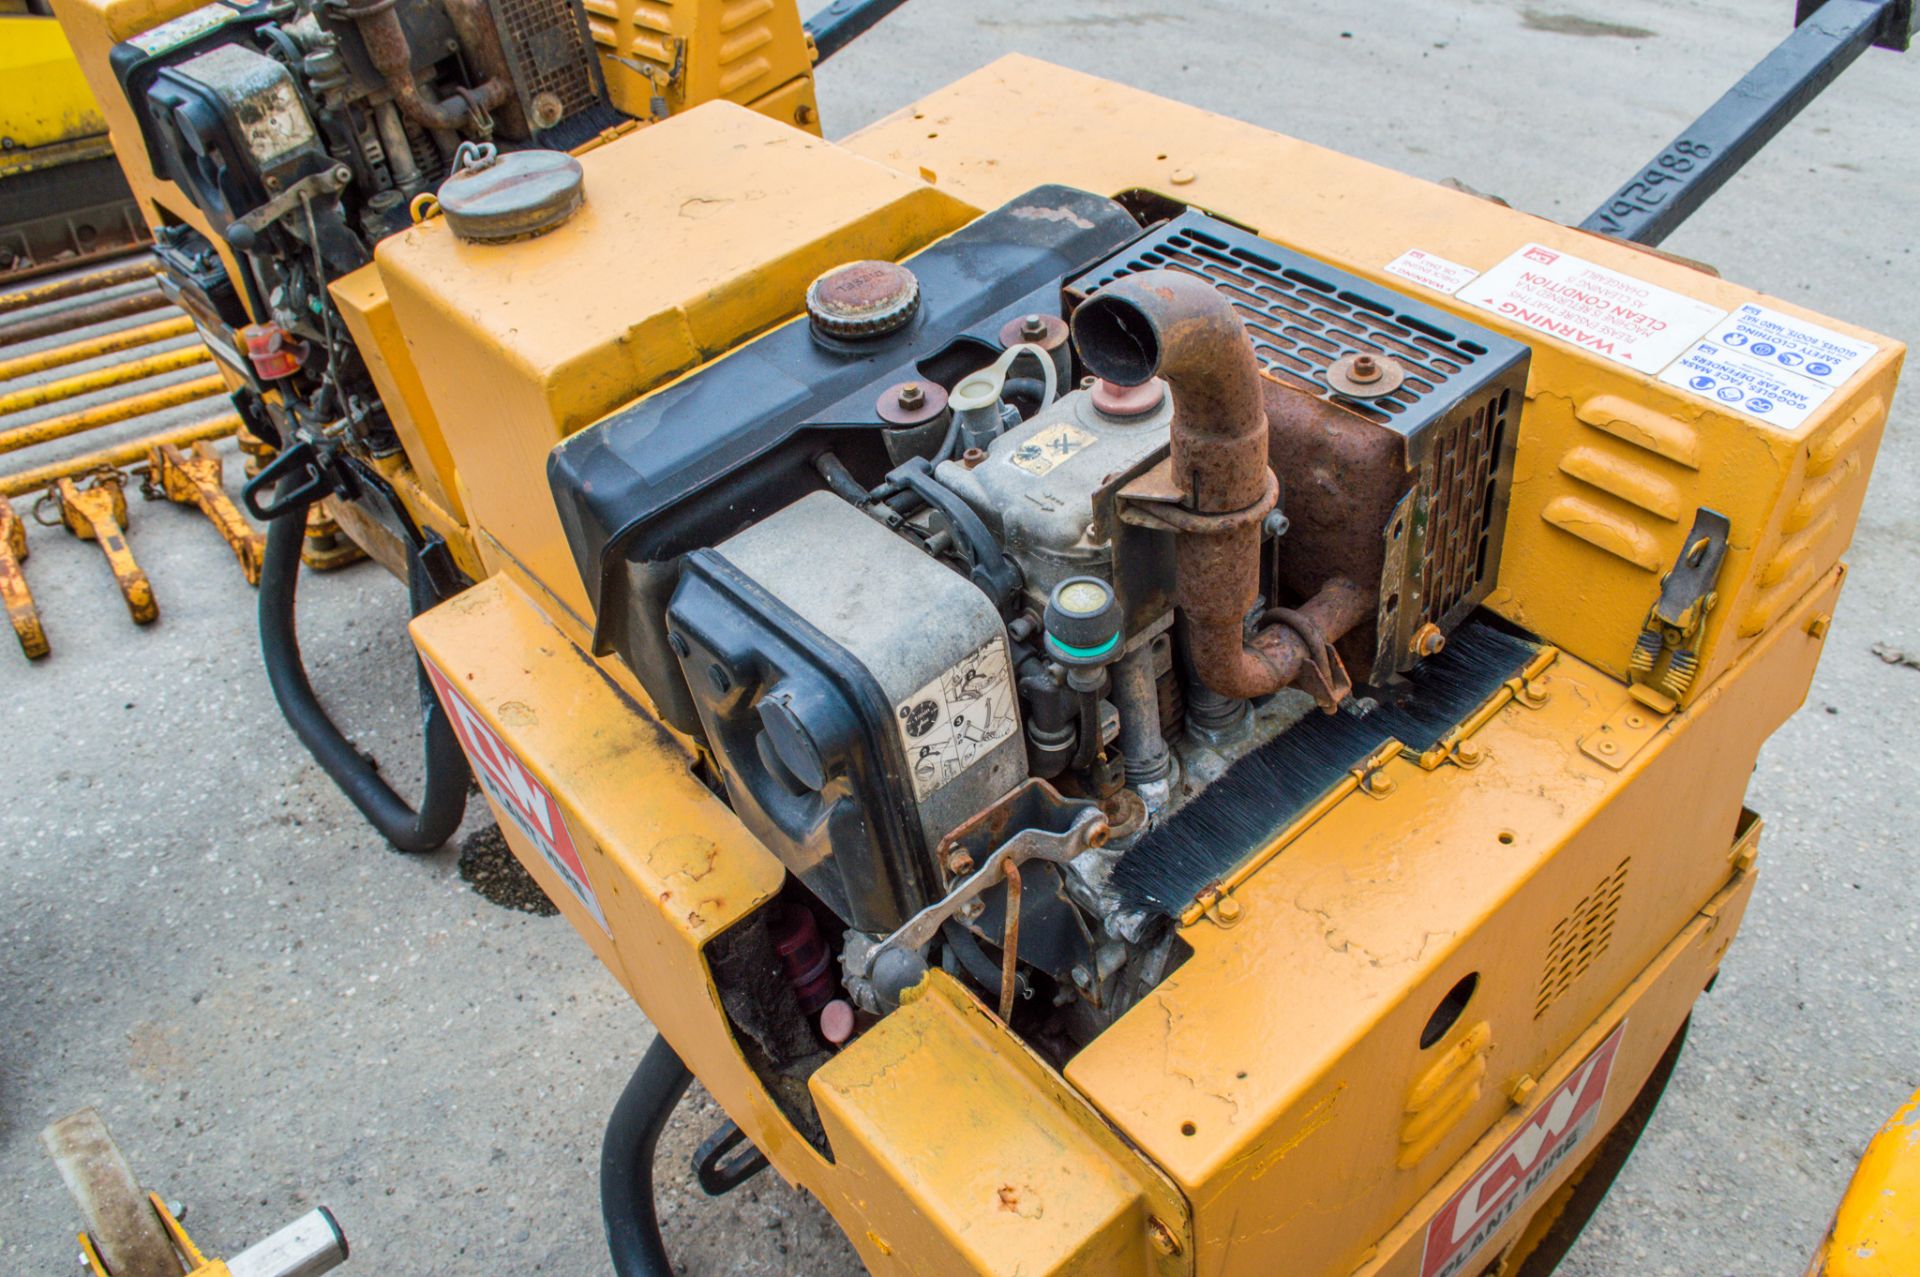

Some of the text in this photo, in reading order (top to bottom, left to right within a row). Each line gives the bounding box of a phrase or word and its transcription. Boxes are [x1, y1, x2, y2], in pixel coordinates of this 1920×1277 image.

[1574, 279, 1632, 303] CLEANING
[1580, 269, 1651, 298] CHARGEABLE
[1518, 271, 1668, 331] CLEAN CONDITION
[1535, 288, 1593, 314] RETURNED
[1496, 301, 1614, 354] WARNING
[1506, 290, 1637, 344] PLEASE ENSURE THAT THIS
[1600, 313, 1654, 337] MACHINE
[1741, 313, 1760, 323] HAT
[1758, 319, 1785, 332] HARD
[1734, 323, 1798, 349] CLOTHING
[1818, 340, 1858, 357] GLOVES,
[1679, 358, 1712, 374] MASK
[1690, 354, 1756, 382] DEFENDERS
[1798, 346, 1842, 365] SAFETY
[1713, 371, 1744, 386] FACE
[1755, 379, 1779, 391] EAR
[1744, 382, 1807, 410] GOGGLES,
[1780, 388, 1809, 402] AND
[446, 686, 555, 844] CW
[482, 770, 539, 847] PLANT
[1451, 1053, 1600, 1244] CW
[1440, 1128, 1579, 1277] PLANT HIRE
